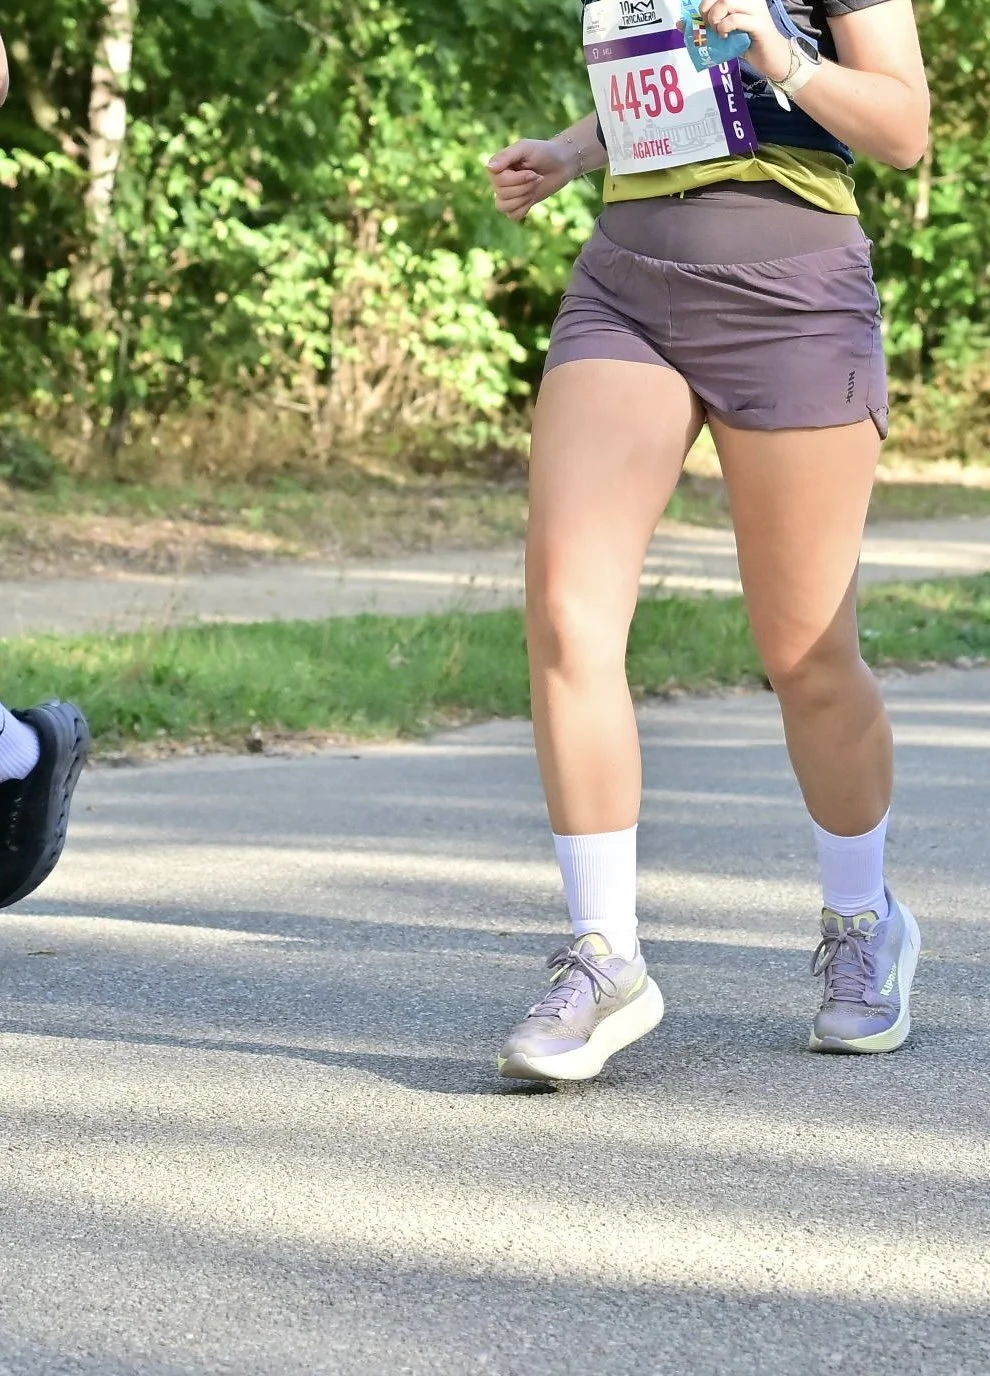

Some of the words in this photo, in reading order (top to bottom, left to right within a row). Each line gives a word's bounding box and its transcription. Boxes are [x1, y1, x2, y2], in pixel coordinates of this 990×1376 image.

[619, 0, 655, 15] 10KM
[610, 64, 685, 122] 4458
[718, 61, 738, 113] ONE
[732, 120, 745, 140] 6
[632, 138, 673, 160] AGATHE
